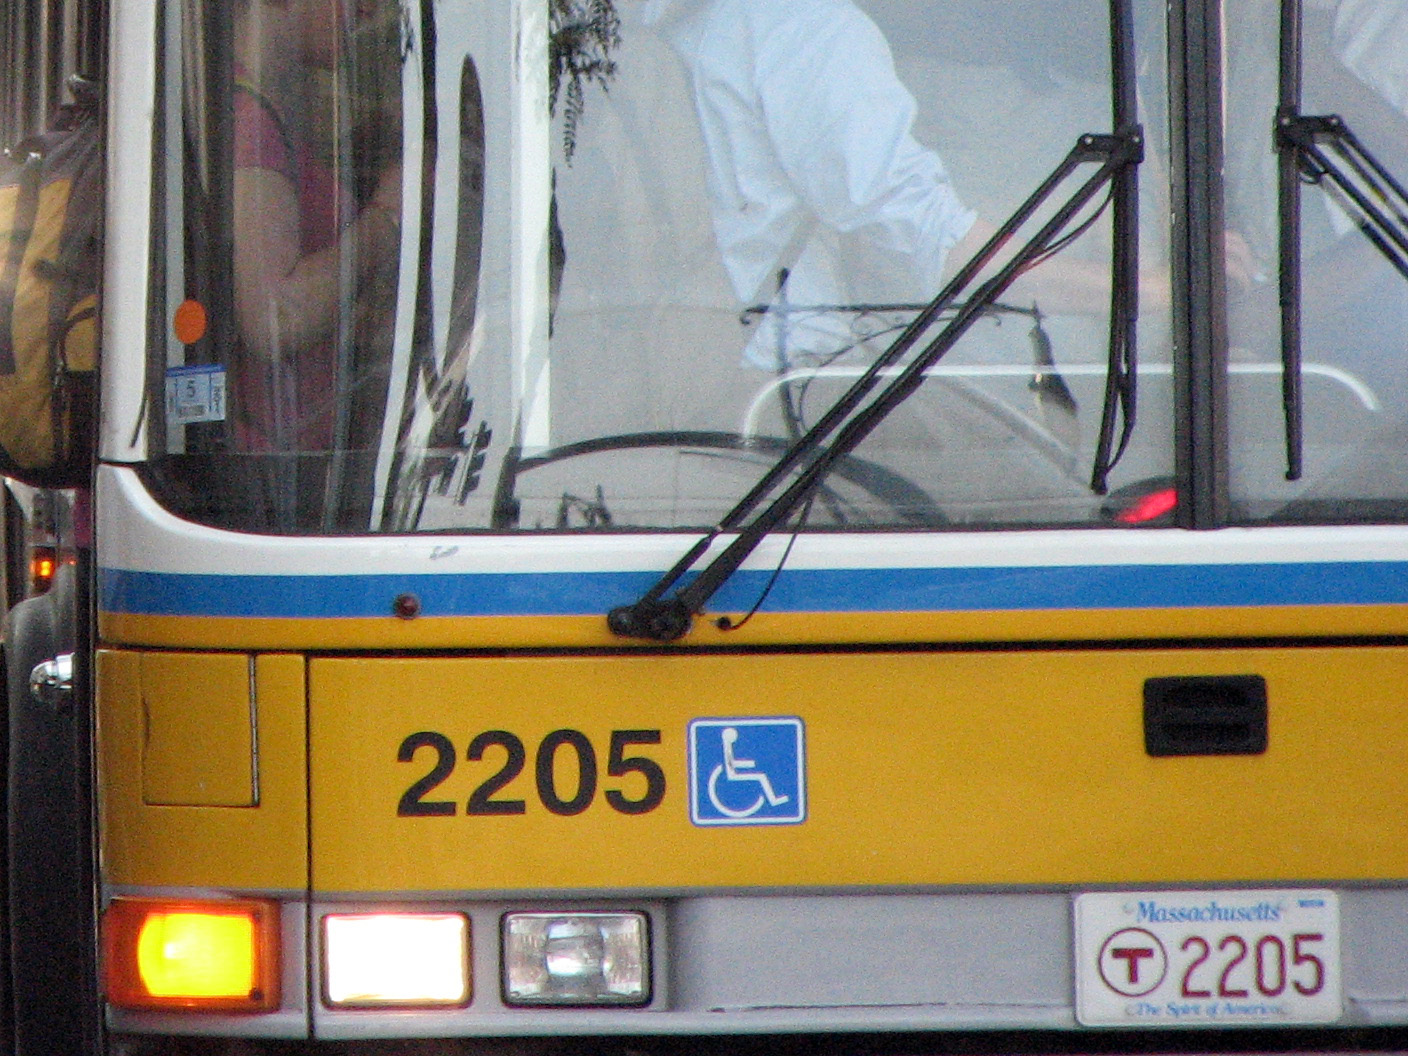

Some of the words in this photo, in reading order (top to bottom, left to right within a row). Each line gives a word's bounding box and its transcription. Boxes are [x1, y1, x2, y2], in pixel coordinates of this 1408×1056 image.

[396, 728, 667, 817] 2205
[1137, 900, 1281, 923] Massachusetts
[1112, 948, 1154, 984] T
[1182, 934, 1324, 998] 2205
